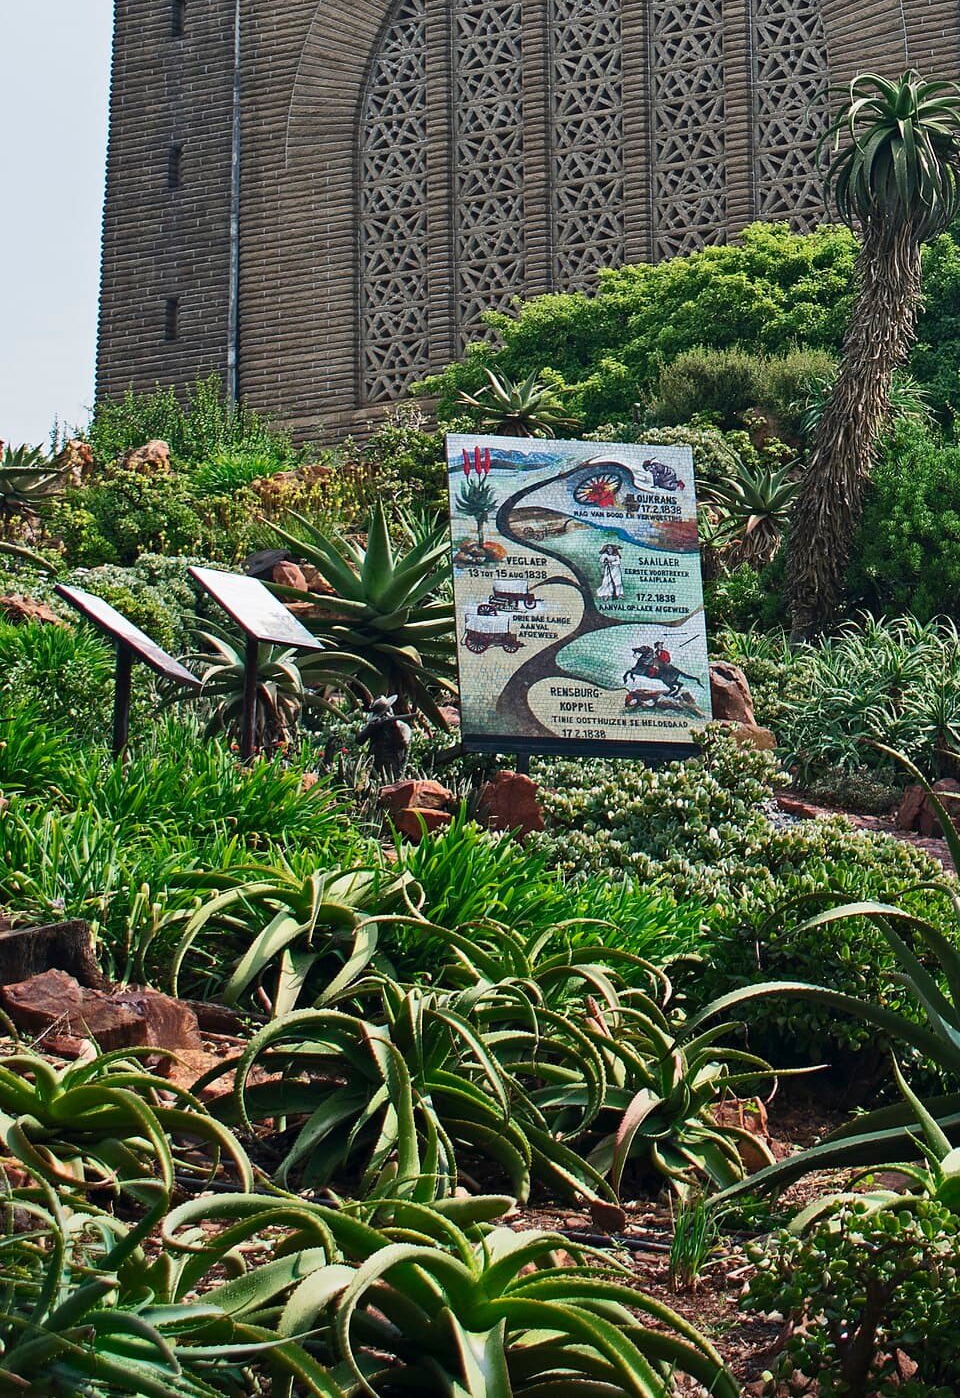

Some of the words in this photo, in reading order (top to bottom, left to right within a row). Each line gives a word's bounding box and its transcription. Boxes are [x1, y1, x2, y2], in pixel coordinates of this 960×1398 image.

[506, 556, 547, 566] VEGLAER
[638, 557, 680, 567] SAAILAER
[468, 568, 479, 578] 13
[496, 569, 507, 578] 15
[525, 570, 547, 579] 1838
[624, 568, 648, 576] EERSTE
[636, 593, 676, 603] 17.2.1838
[547, 616, 571, 625] LANGE
[518, 631, 559, 639] AFGEWEER
[550, 687, 602, 698] RENSBURG-
[560, 701, 595, 712] KOPPIE
[576, 716, 627, 726] OOSTHUIZEN
